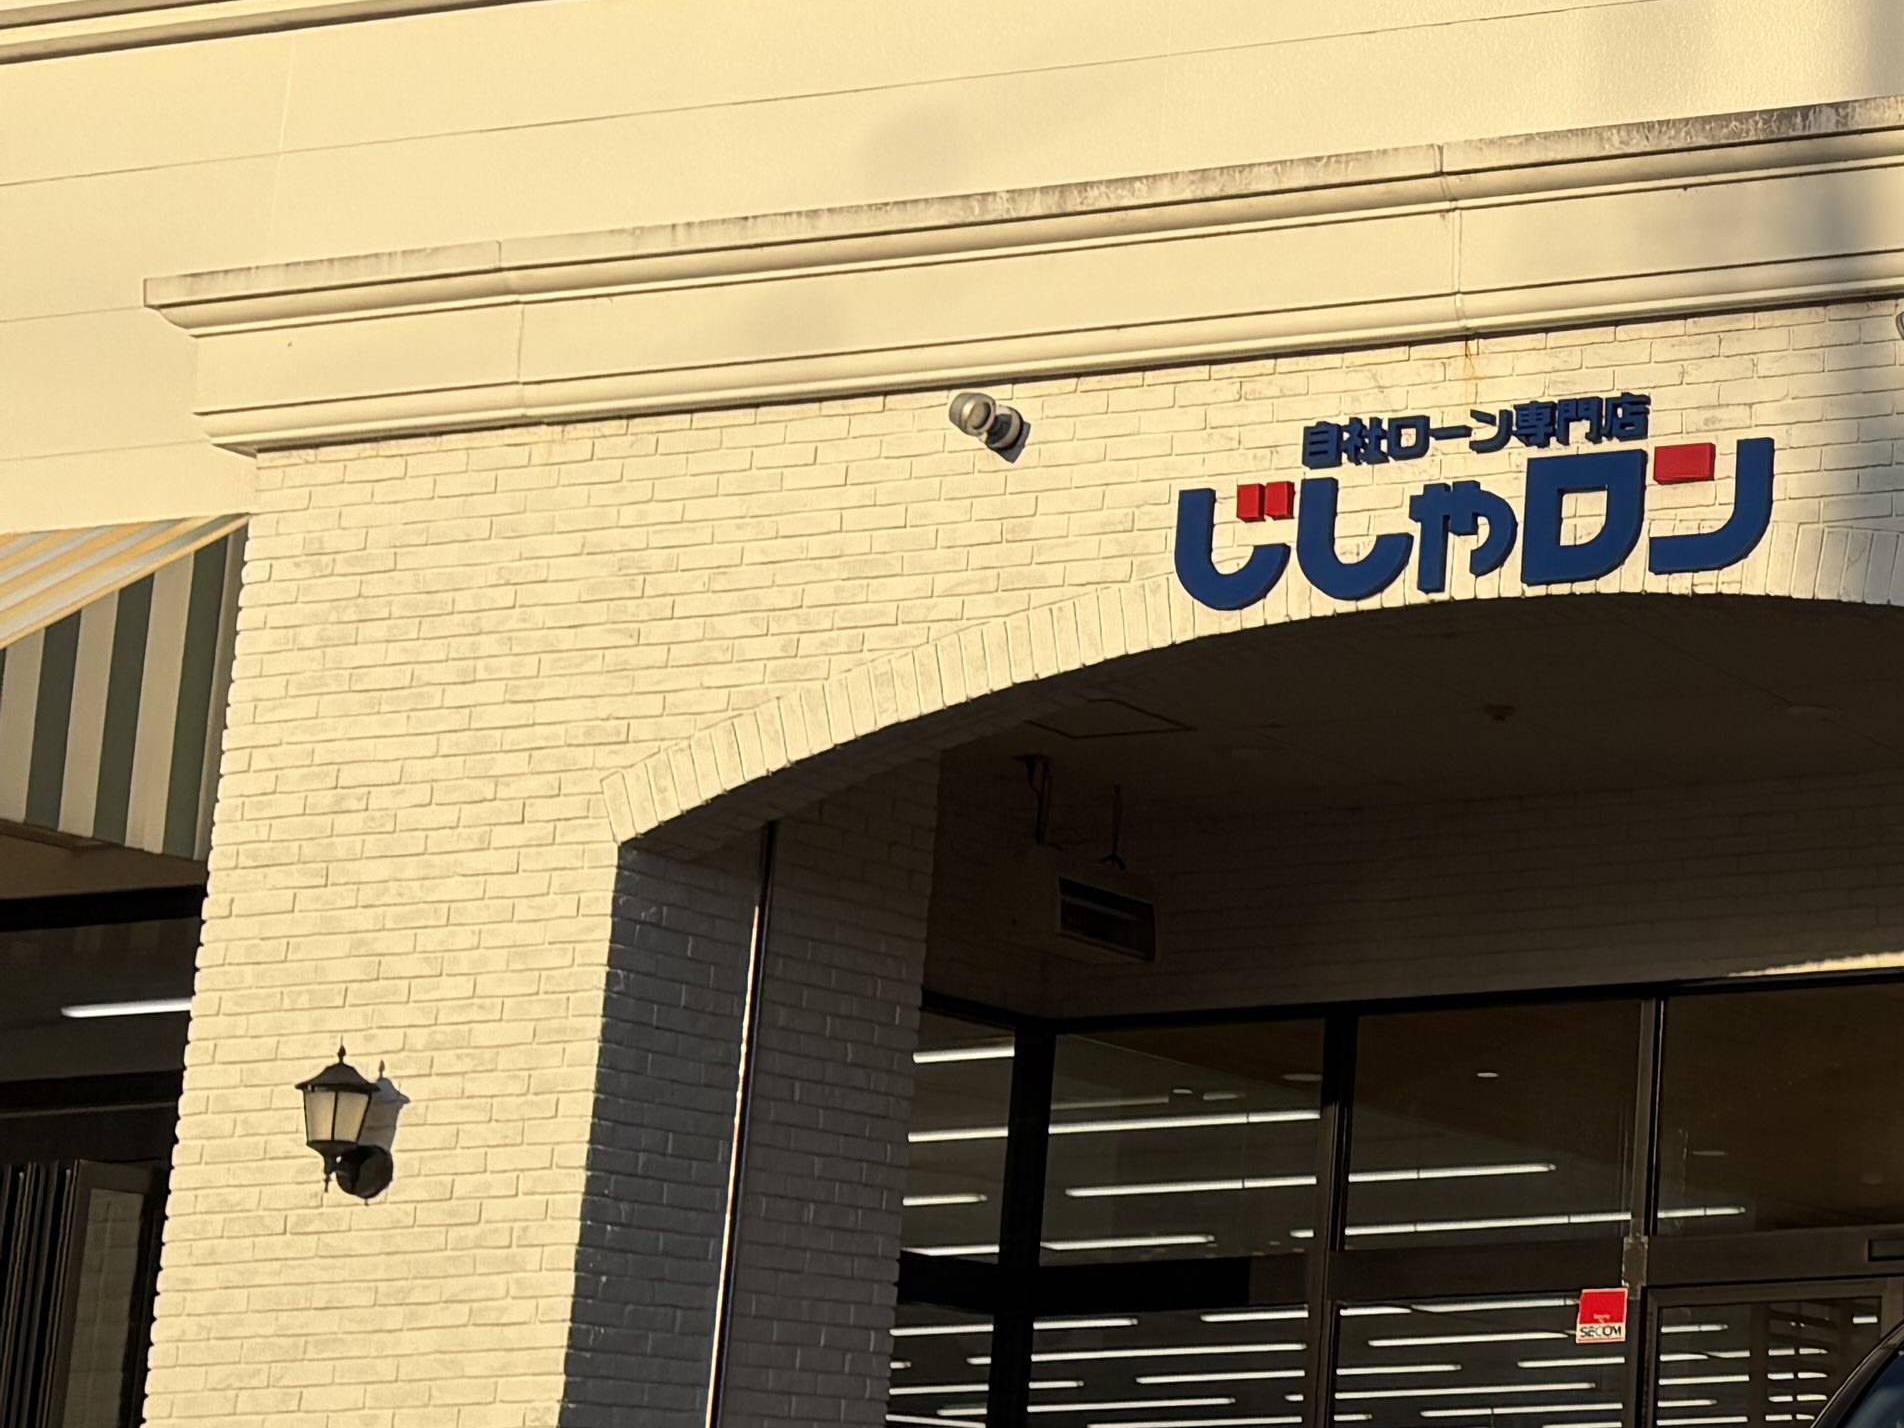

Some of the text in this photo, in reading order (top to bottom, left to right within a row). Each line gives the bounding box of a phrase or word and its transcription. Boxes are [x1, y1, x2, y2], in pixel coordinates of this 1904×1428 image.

[1302, 393, 1650, 469] 自社ローン専門店
[1175, 437, 1774, 611] じしゃロン
